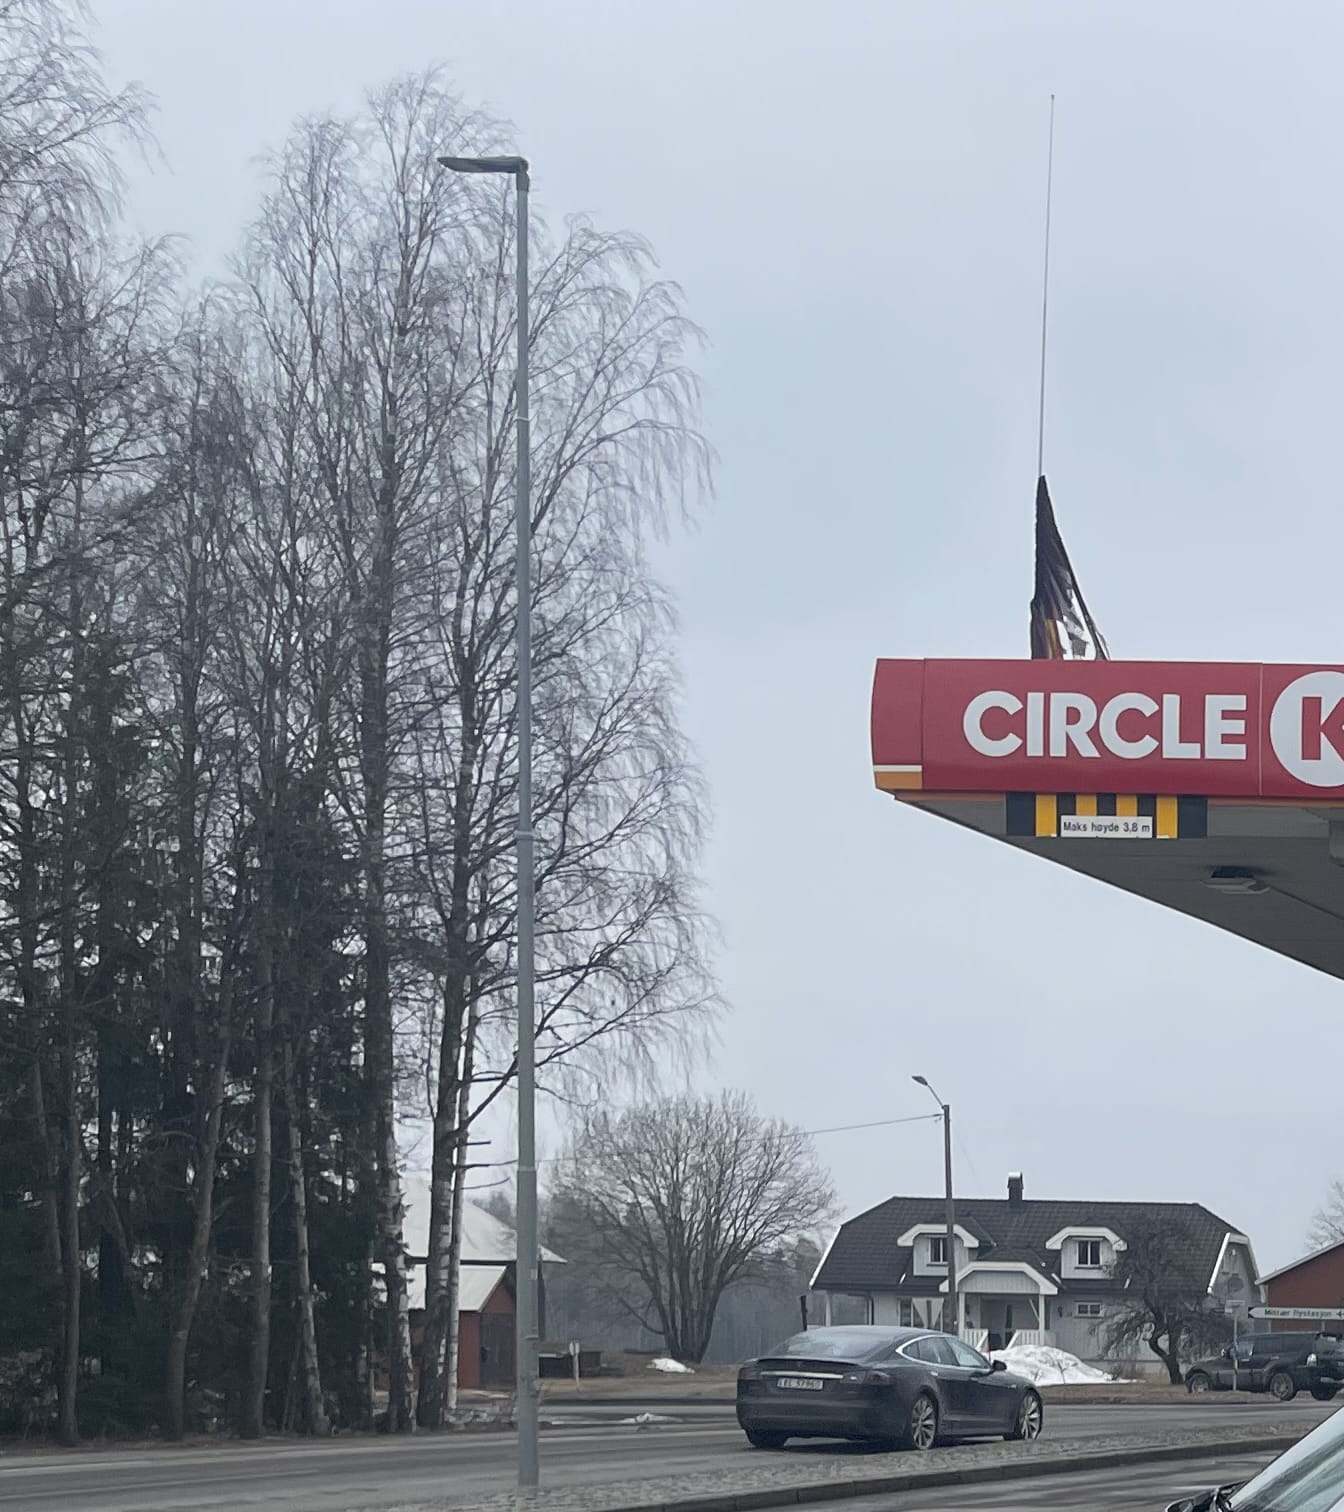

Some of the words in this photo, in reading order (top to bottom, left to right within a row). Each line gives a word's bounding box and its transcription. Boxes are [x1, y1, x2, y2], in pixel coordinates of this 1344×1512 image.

[962, 690, 1247, 760] CIRCLE
[1063, 821, 1087, 832] Maks
[1091, 821, 1119, 834] høyde
[1141, 824, 1150, 833] m
